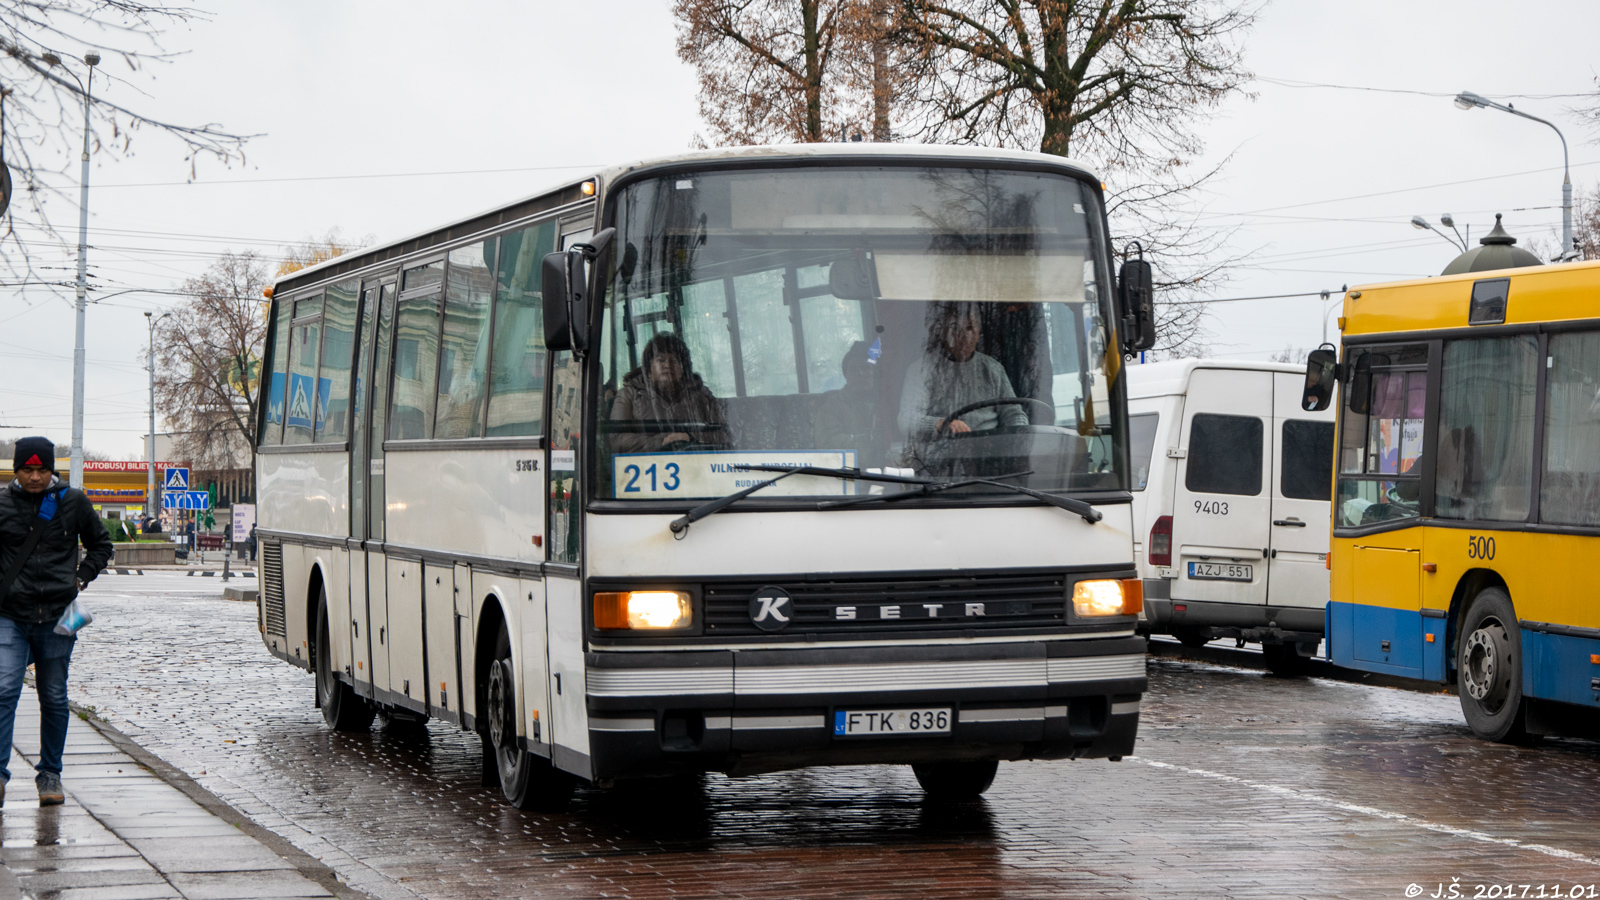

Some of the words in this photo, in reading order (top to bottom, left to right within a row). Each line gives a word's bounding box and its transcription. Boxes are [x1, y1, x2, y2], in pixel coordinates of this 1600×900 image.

[127, 462, 156, 470] BILIET
[624, 462, 681, 493] 213
[1194, 500, 1229, 515] 9403
[1468, 535, 1496, 561] 500
[1196, 564, 1222, 576] AZJ
[1228, 566, 1250, 578] 551
[836, 603, 986, 619] SETR
[848, 712, 894, 732] FTK
[909, 711, 948, 730] 836
